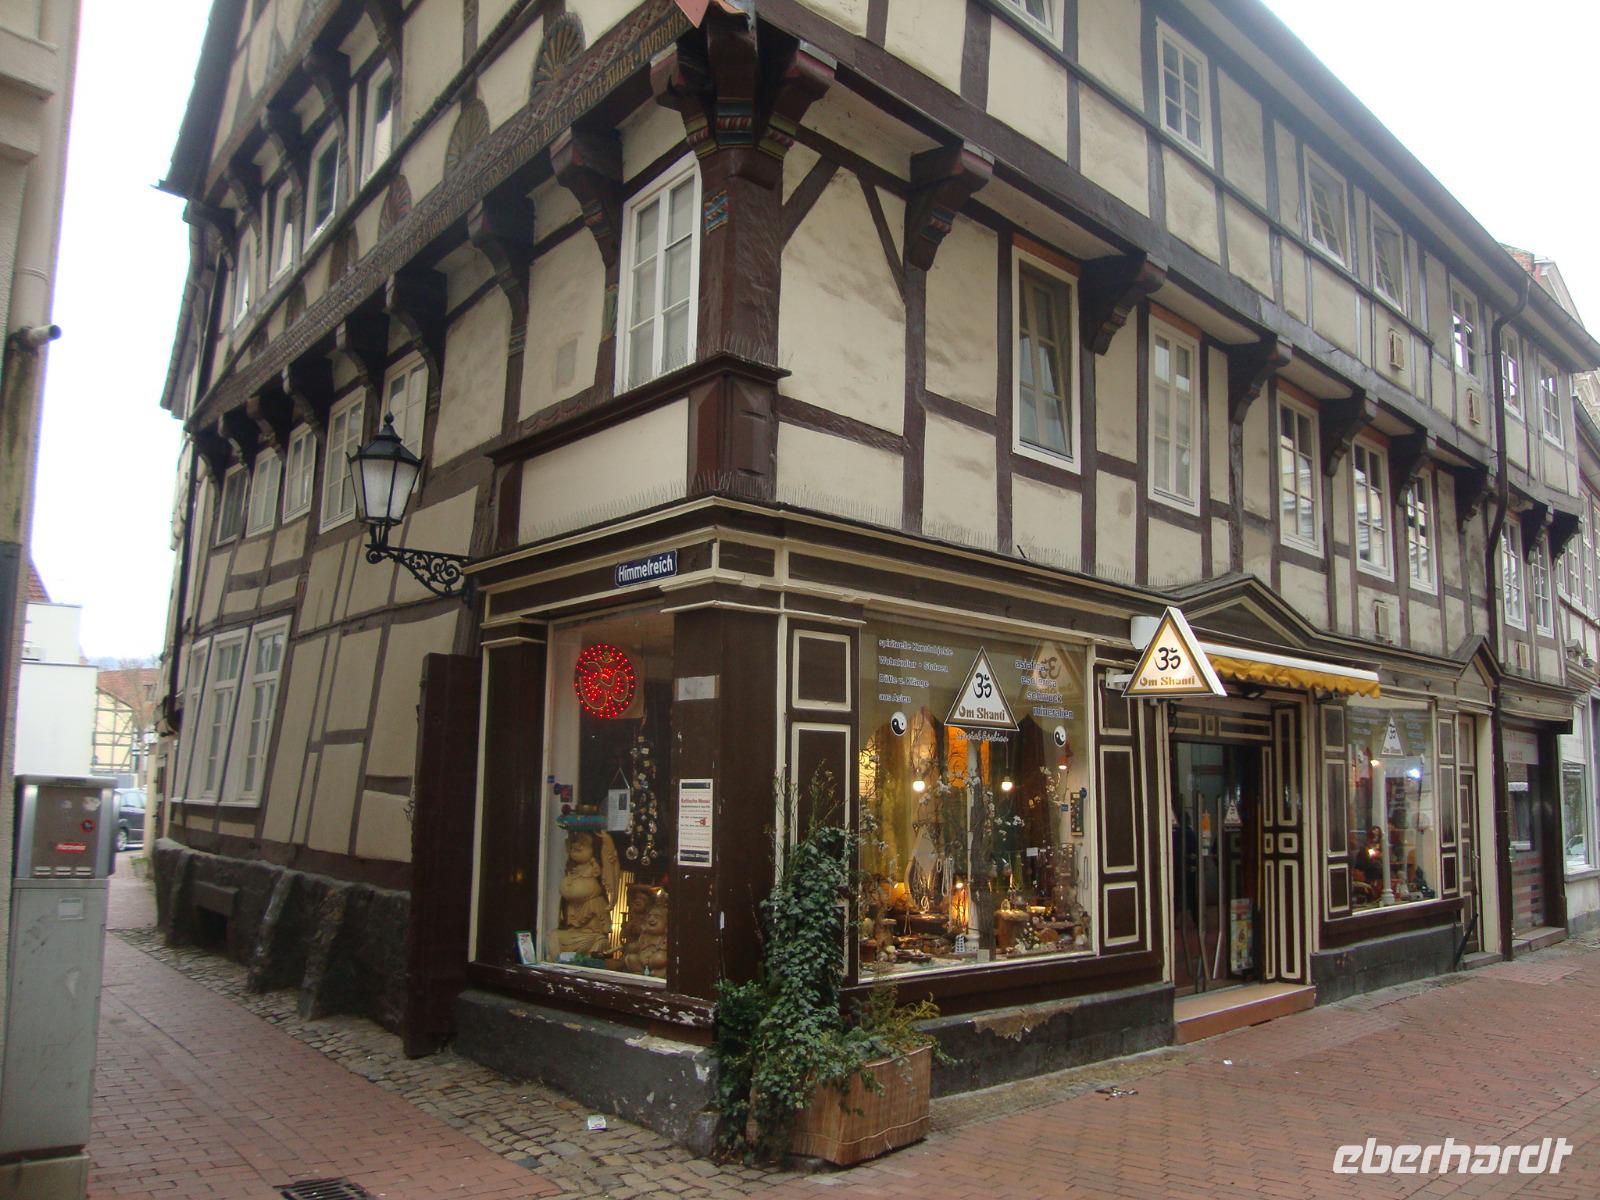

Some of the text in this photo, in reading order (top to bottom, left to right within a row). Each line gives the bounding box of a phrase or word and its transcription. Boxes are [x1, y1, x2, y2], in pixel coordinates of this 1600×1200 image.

[618, 554, 673, 583] Himmelreich
[1140, 675, 1195, 687] Om Shanti
[958, 705, 1006, 721] Om Shanti
